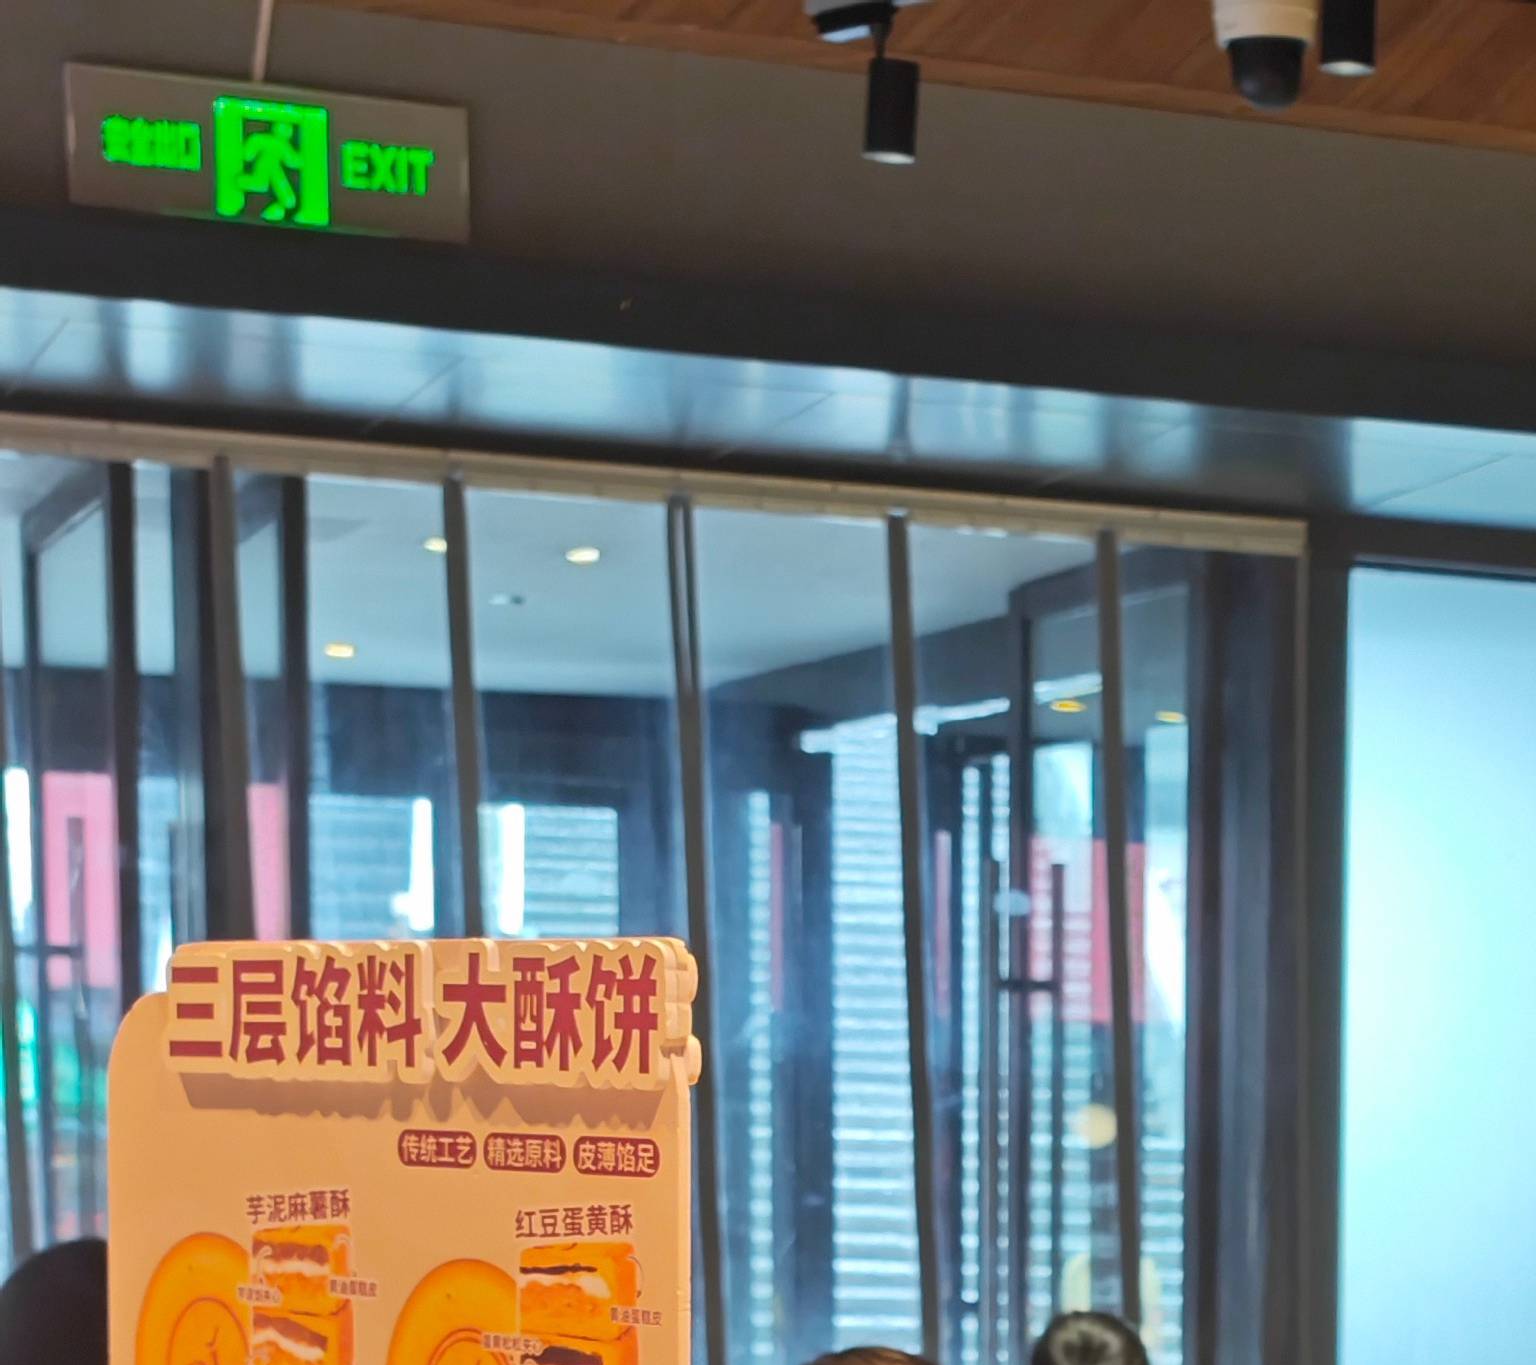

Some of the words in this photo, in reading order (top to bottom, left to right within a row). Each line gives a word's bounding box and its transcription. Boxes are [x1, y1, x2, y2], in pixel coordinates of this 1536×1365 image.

[341, 140, 434, 195] EXIT
[168, 953, 423, 1068] 三层馅料
[441, 951, 659, 1075] 大酥饼
[401, 1132, 474, 1168] 传统工艺
[486, 1136, 563, 1171] 精选原料
[577, 1139, 656, 1175] 皮薄馅足
[246, 1189, 351, 1225] 芋泥麻薯酥
[515, 1204, 634, 1239] 红豆蛋黄酥
